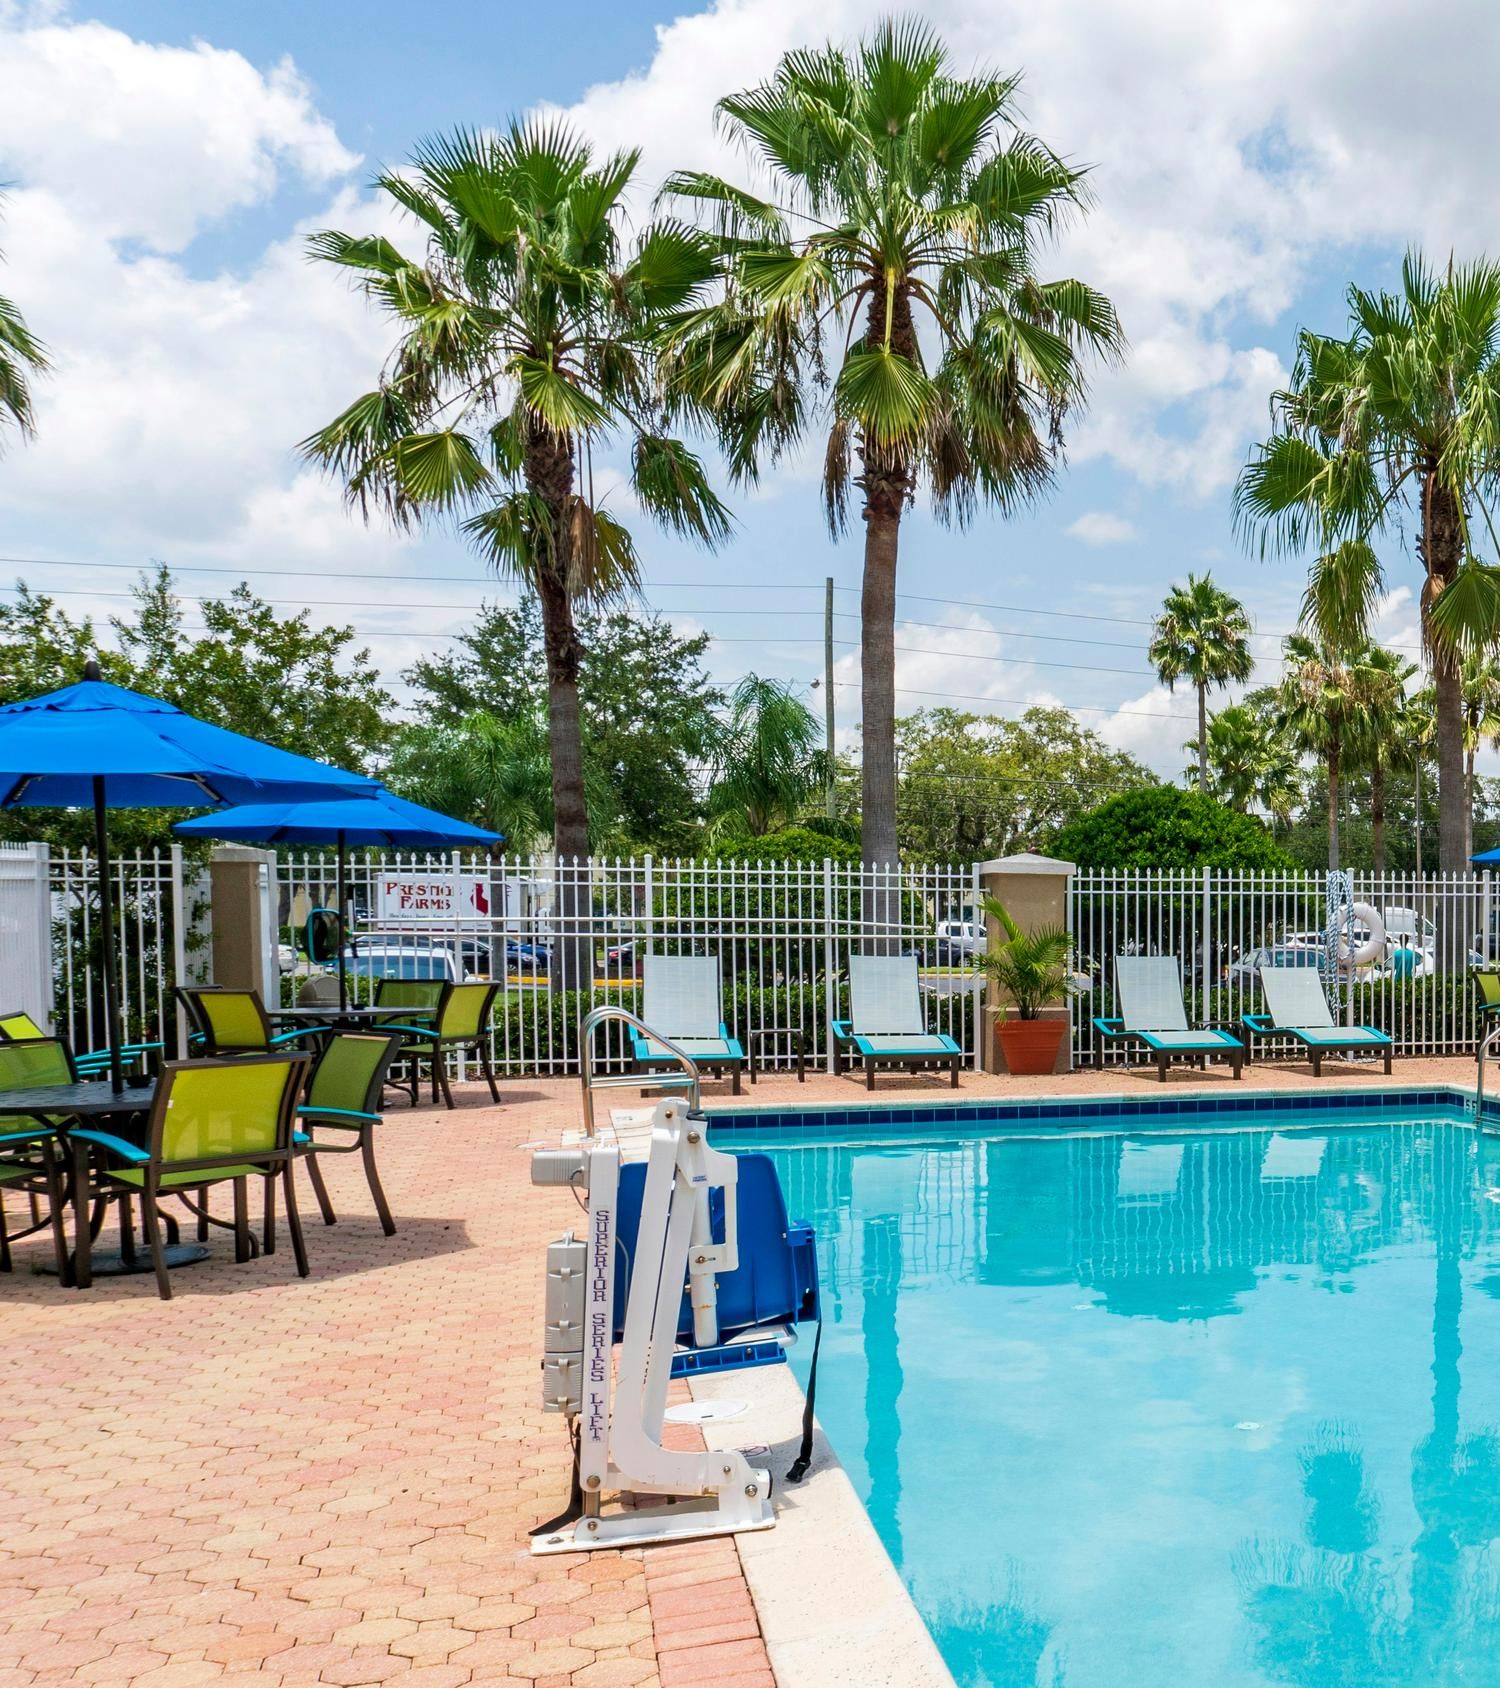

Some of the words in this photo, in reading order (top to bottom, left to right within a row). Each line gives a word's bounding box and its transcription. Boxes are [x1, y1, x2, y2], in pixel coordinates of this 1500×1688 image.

[593, 1210, 609, 1302] SUPERIOR
[590, 1313, 606, 1382] SERIES
[590, 1393, 604, 1439] LIFT
